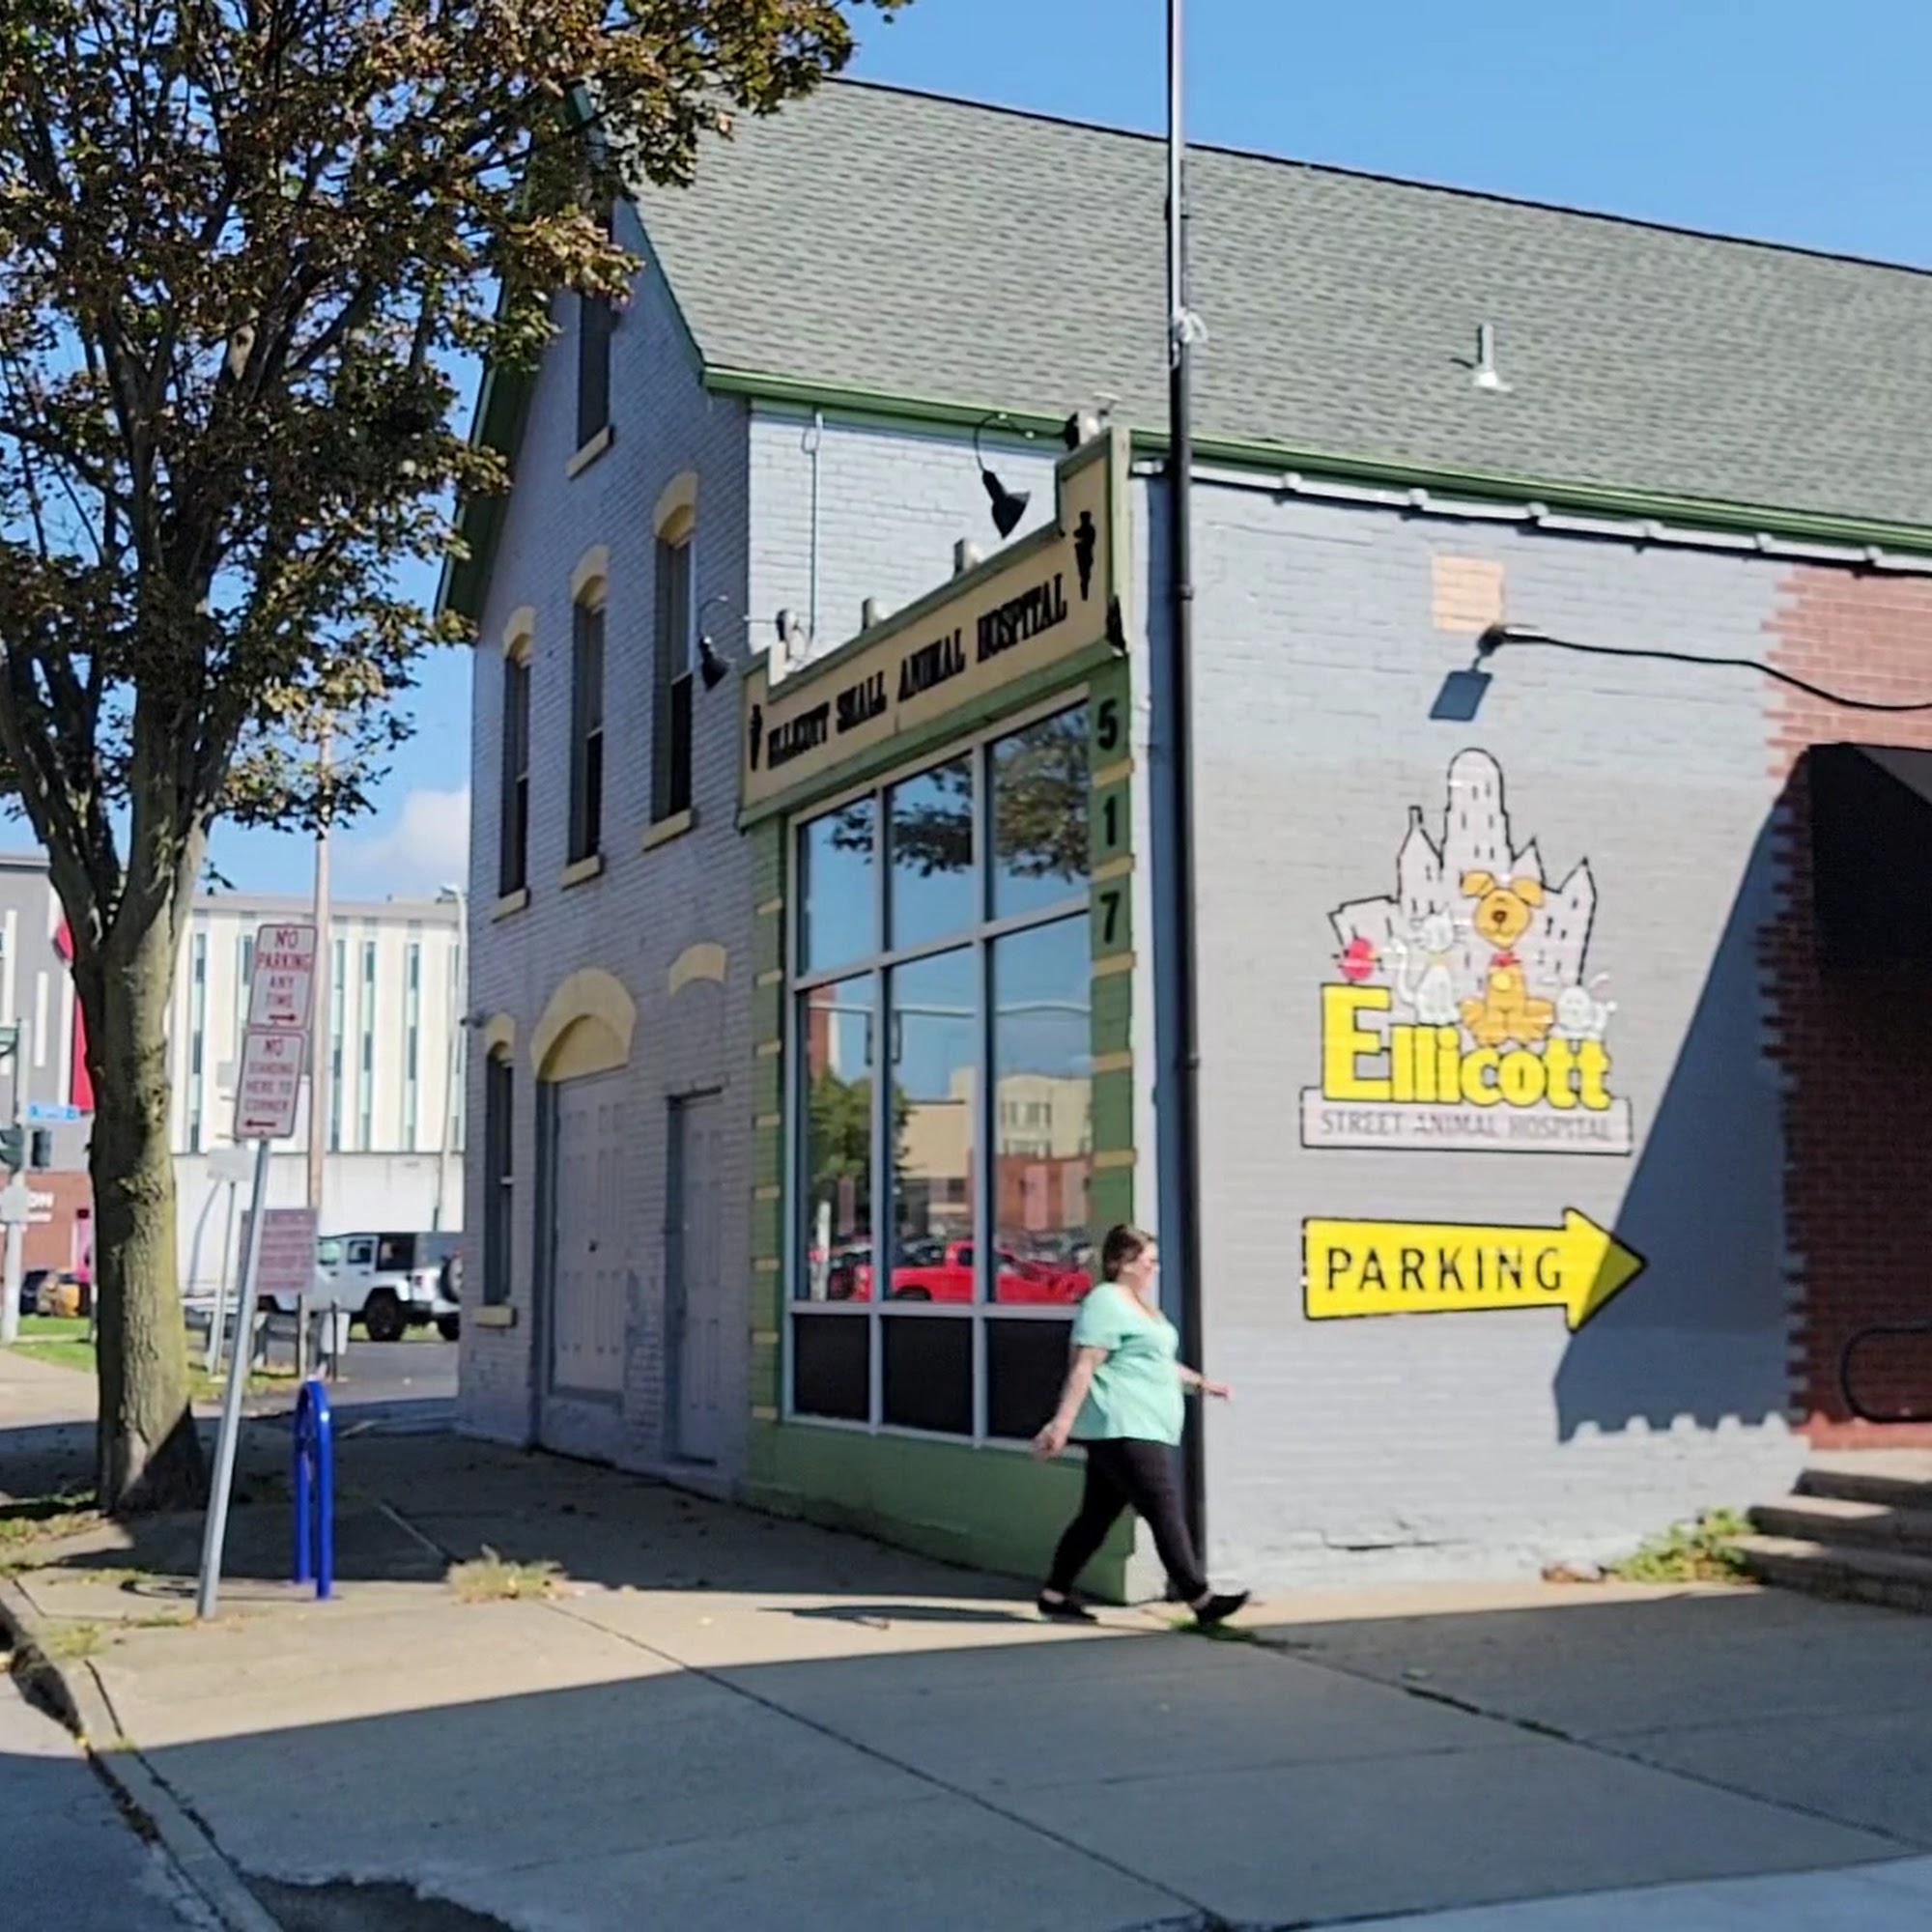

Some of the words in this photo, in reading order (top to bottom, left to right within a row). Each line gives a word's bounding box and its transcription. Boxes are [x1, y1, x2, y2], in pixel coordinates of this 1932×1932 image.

[837, 670, 887, 734] SMALL
[896, 627, 965, 703] ANIMAL
[977, 573, 1067, 664] HOSPITAL
[275, 930, 298, 949] NO
[257, 952, 311, 972] PARKING
[263, 1038, 285, 1057] NO
[1320, 982, 1612, 1111] Ellicott
[1321, 1110, 1402, 1136] STREET
[1414, 1112, 1498, 1137] ANIMAL
[1508, 1113, 1612, 1142] HOSPITAL
[1326, 1246, 1562, 1292] PARKING
